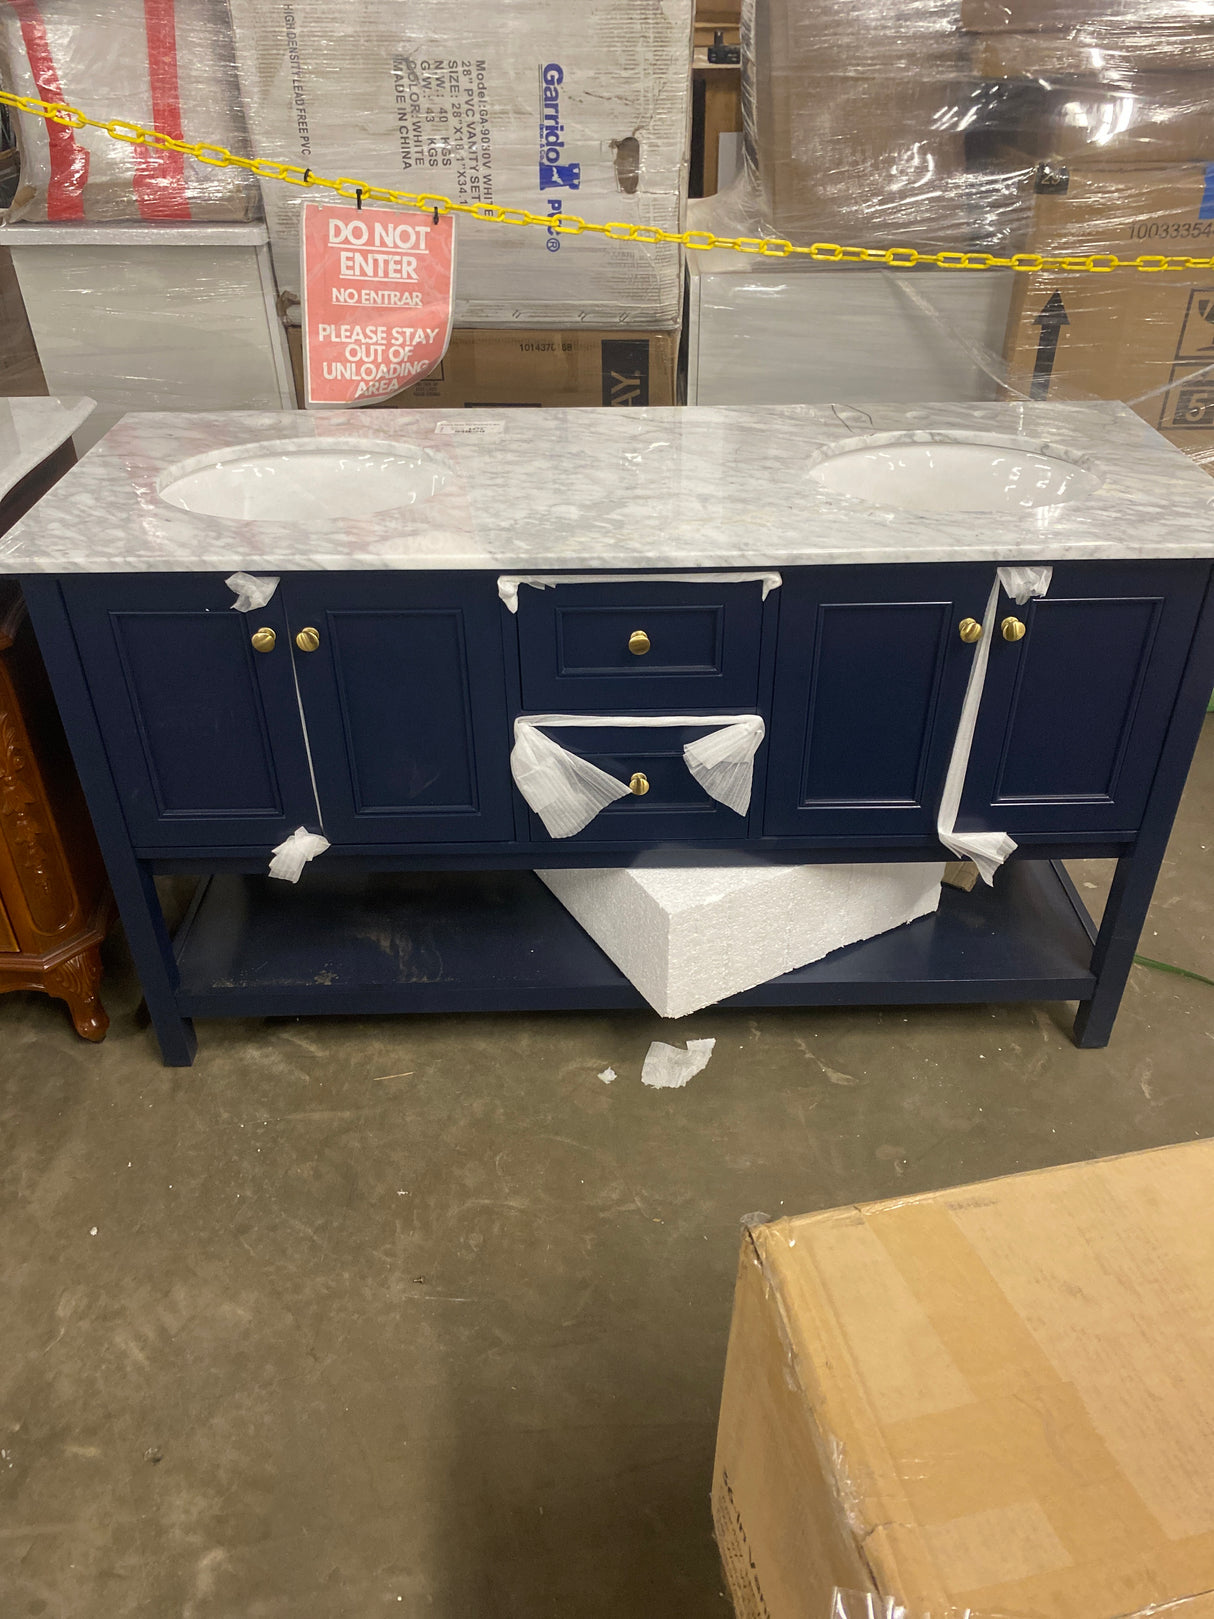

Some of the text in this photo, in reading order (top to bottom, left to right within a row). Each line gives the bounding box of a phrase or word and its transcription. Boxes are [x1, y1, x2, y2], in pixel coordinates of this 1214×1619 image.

[284, 4, 311, 156] HIGH DENSITY LEAD FREE PVC
[448, 60, 460, 98] SIZE:
[393, 59, 412, 170] MADE IN CHINA
[426, 107, 435, 123] 43
[438, 107, 449, 123] 40
[464, 88, 475, 118] PVC
[543, 63, 565, 164] Garrido
[427, 137, 438, 167] KGS
[440, 136, 452, 167] KGS
[466, 121, 479, 173] VANITY
[470, 175, 481, 202] SET
[483, 174, 494, 217] WHITE
[329, 218, 431, 250] DO NOT
[1128, 222, 1214, 239] 10033354
[340, 251, 419, 280] ENTER
[332, 288, 423, 306] NO ENTRAR
[318, 324, 440, 345] PLEASE STAY
[345, 344, 414, 362] OUT OF
[323, 360, 430, 380] UNLOADING
[355, 379, 399, 398] AREA
